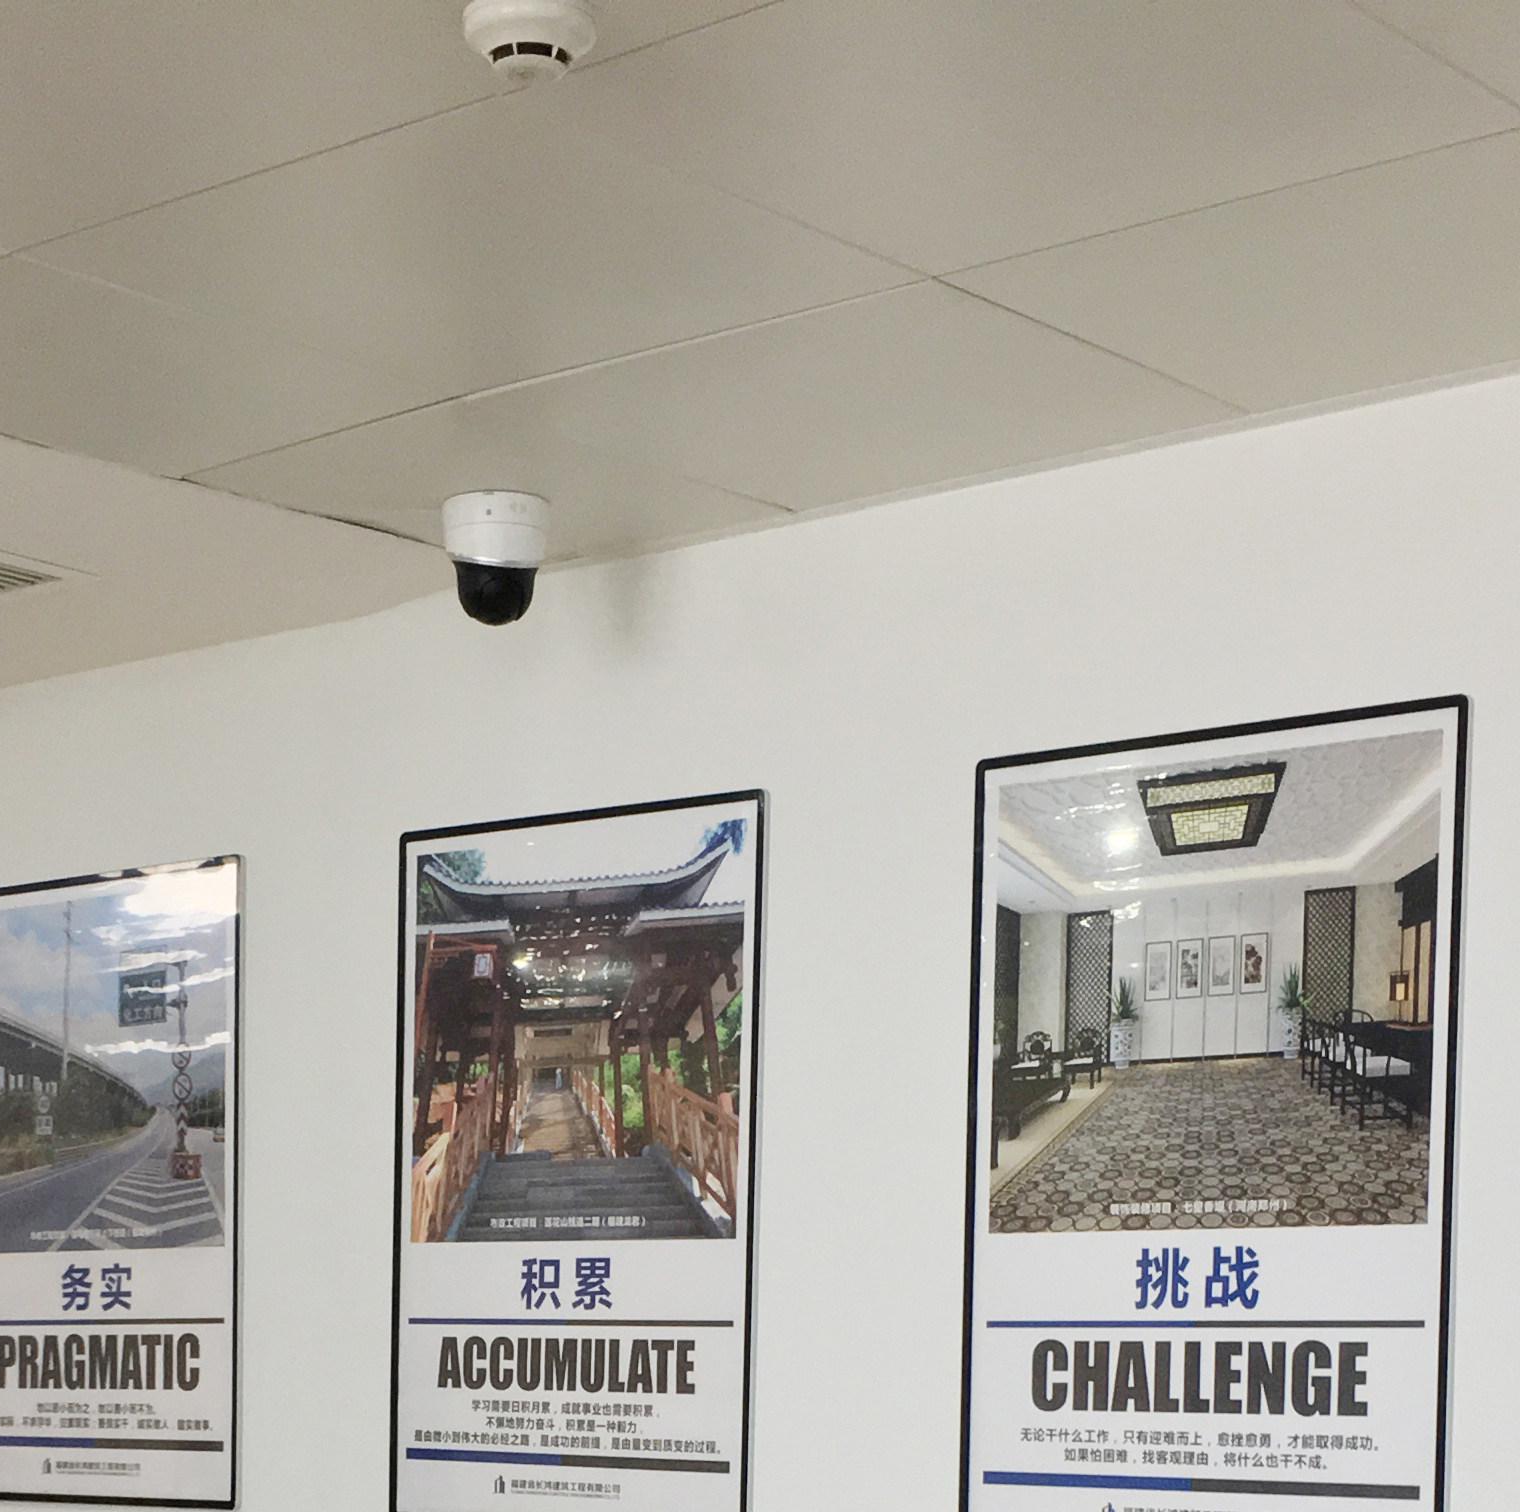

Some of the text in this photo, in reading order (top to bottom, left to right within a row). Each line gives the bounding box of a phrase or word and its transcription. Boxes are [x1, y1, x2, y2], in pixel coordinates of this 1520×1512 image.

[61, 1263, 132, 1311] 务实
[520, 1257, 613, 1310] 积累
[1135, 1246, 1260, 1310] 挑战
[437, 1335, 695, 1395] ACCUMULATE
[1031, 1338, 1368, 1417] CHALLENGE
